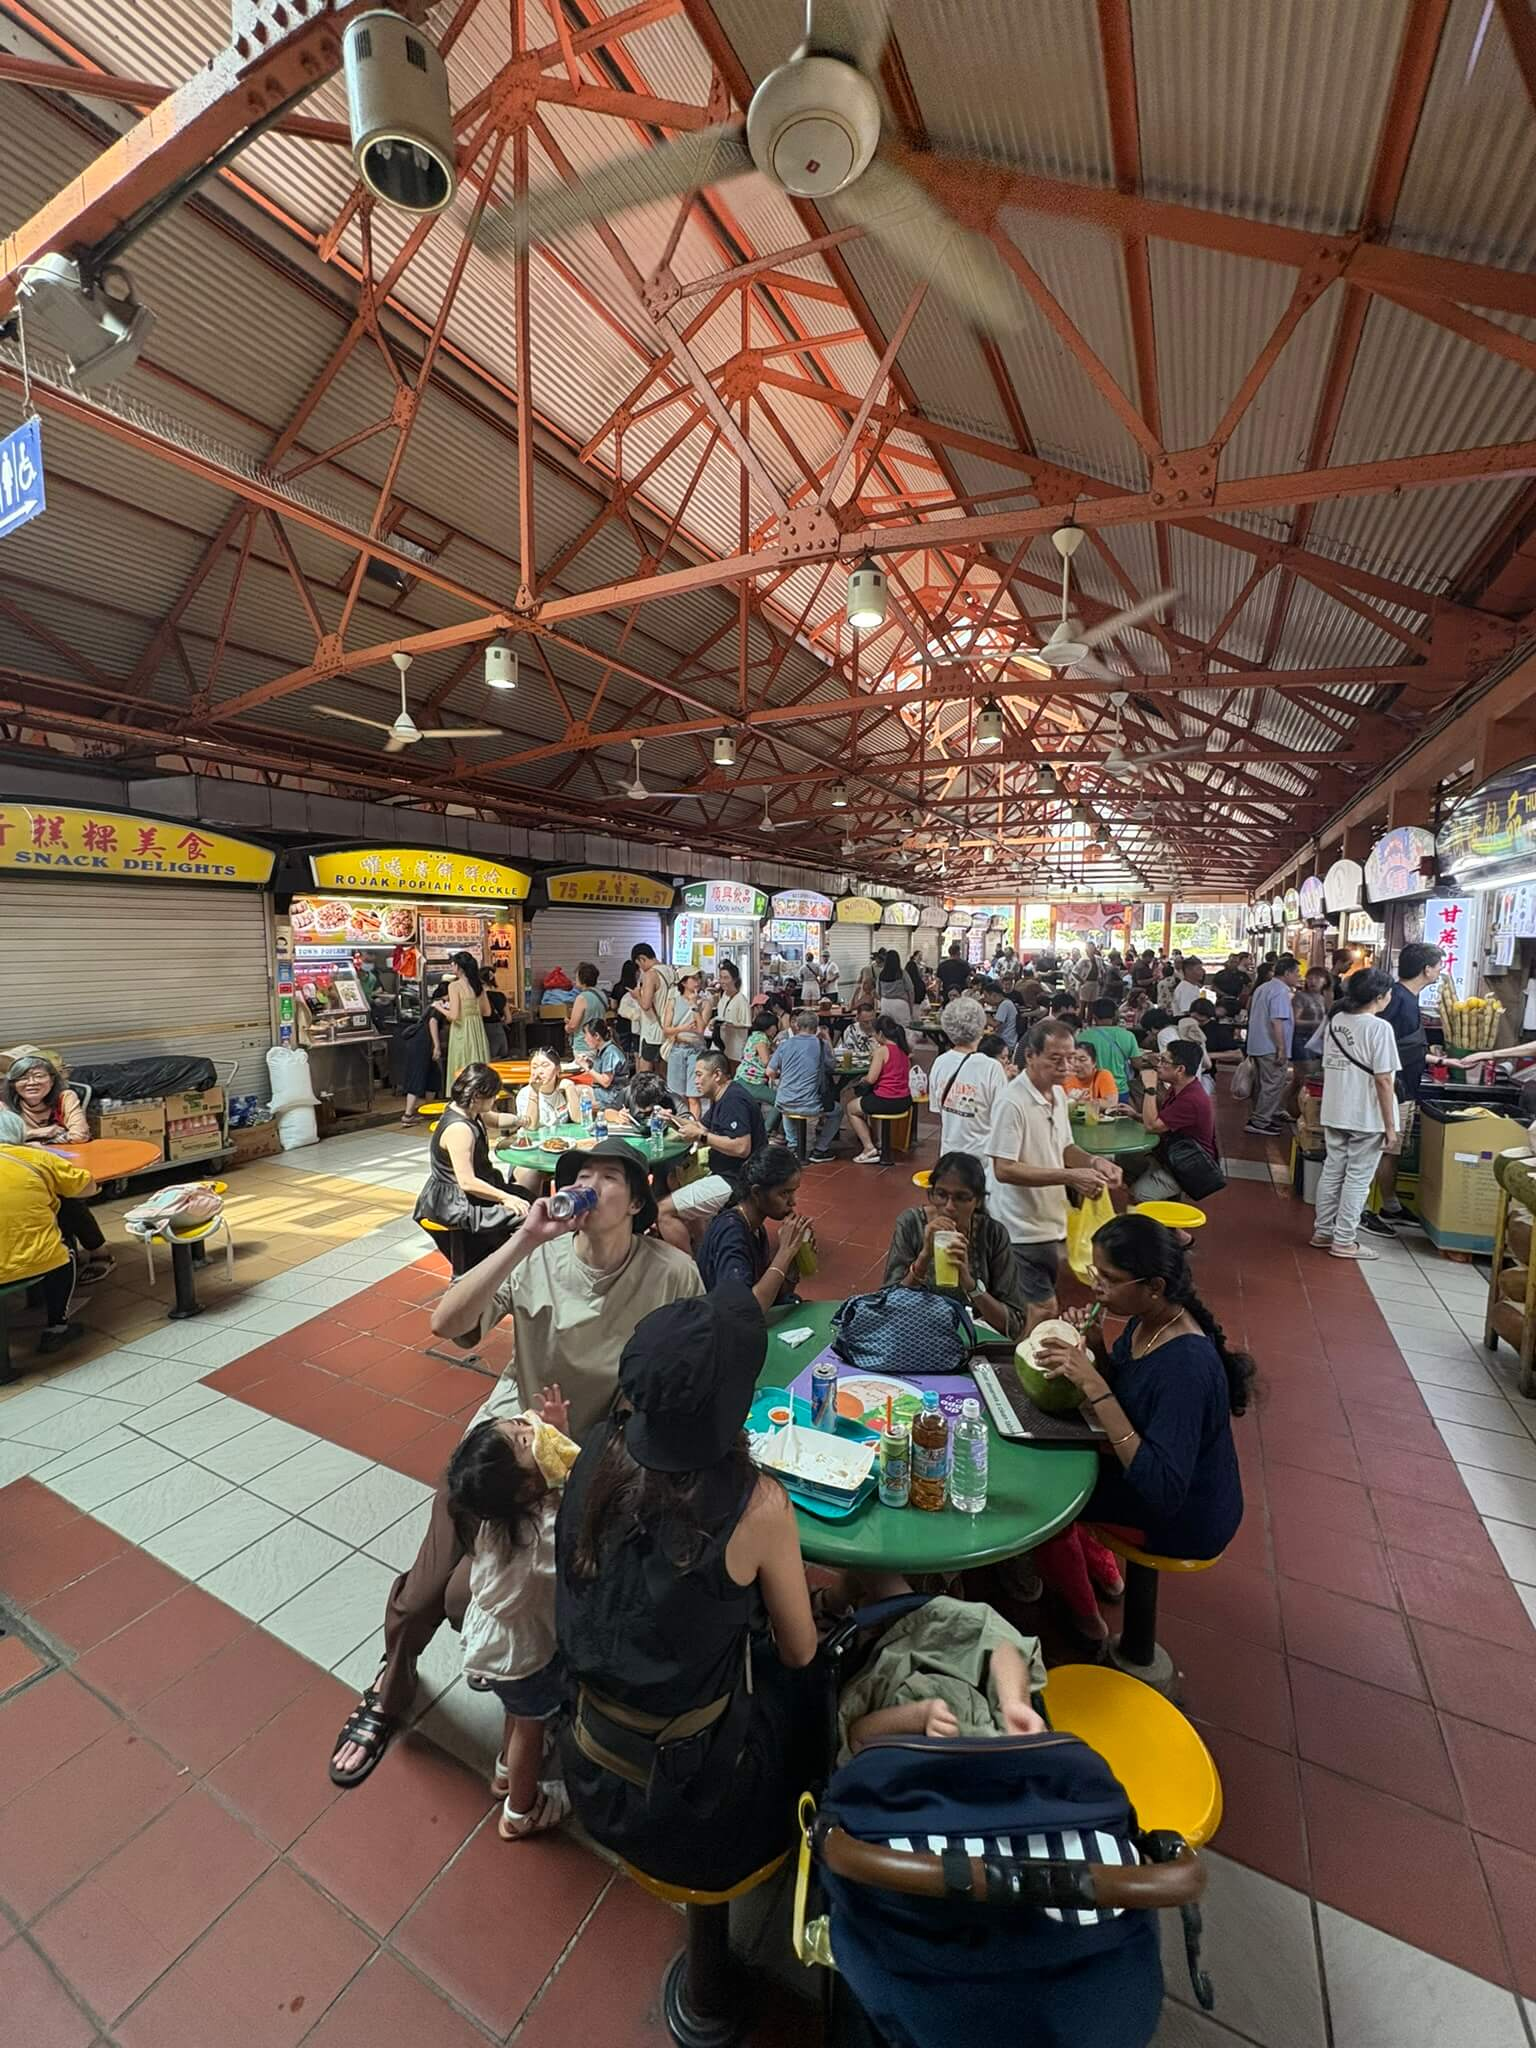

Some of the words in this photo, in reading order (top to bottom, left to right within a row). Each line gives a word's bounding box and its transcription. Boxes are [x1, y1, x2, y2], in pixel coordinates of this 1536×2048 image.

[15, 851, 108, 868] SNACK
[123, 858, 236, 876] DELIGHTS
[335, 874, 390, 887] ROJAK
[399, 879, 451, 891] POPIAH
[457, 884, 465, 892] &
[470, 884, 518, 896] COCKLE
[559, 881, 578, 899] 75
